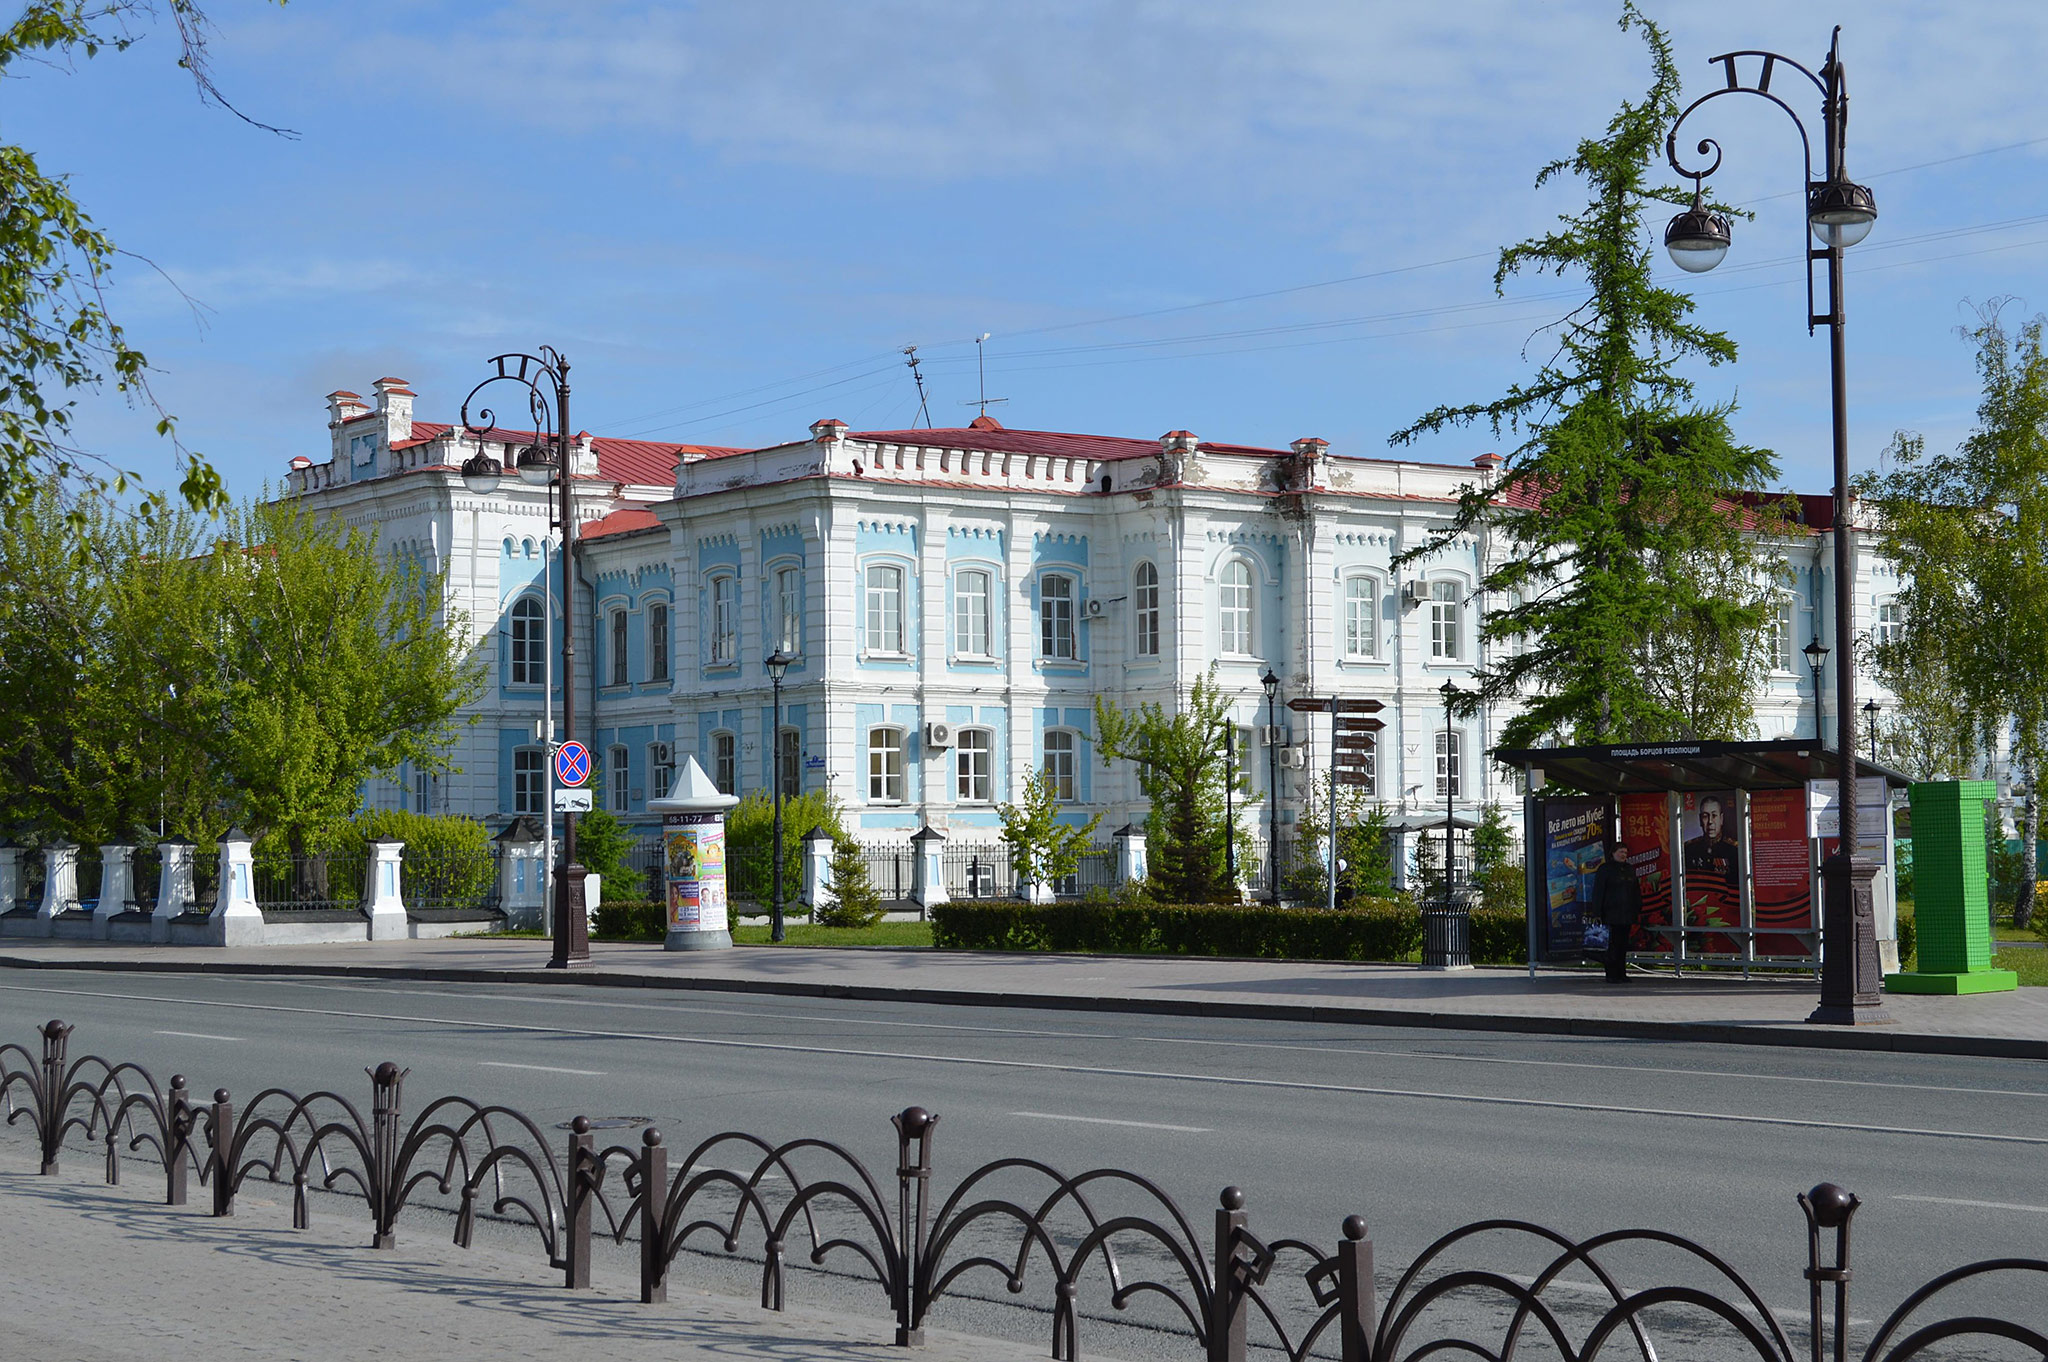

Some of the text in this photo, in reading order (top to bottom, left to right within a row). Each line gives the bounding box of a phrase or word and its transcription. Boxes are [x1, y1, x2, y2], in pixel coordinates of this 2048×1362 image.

[1611, 746, 1700, 757] ПЛОЩАДЬ БОРЦОВ РЕВОЛЮЦИИ
[1548, 806, 1604, 834] Всё лето на Кубе!
